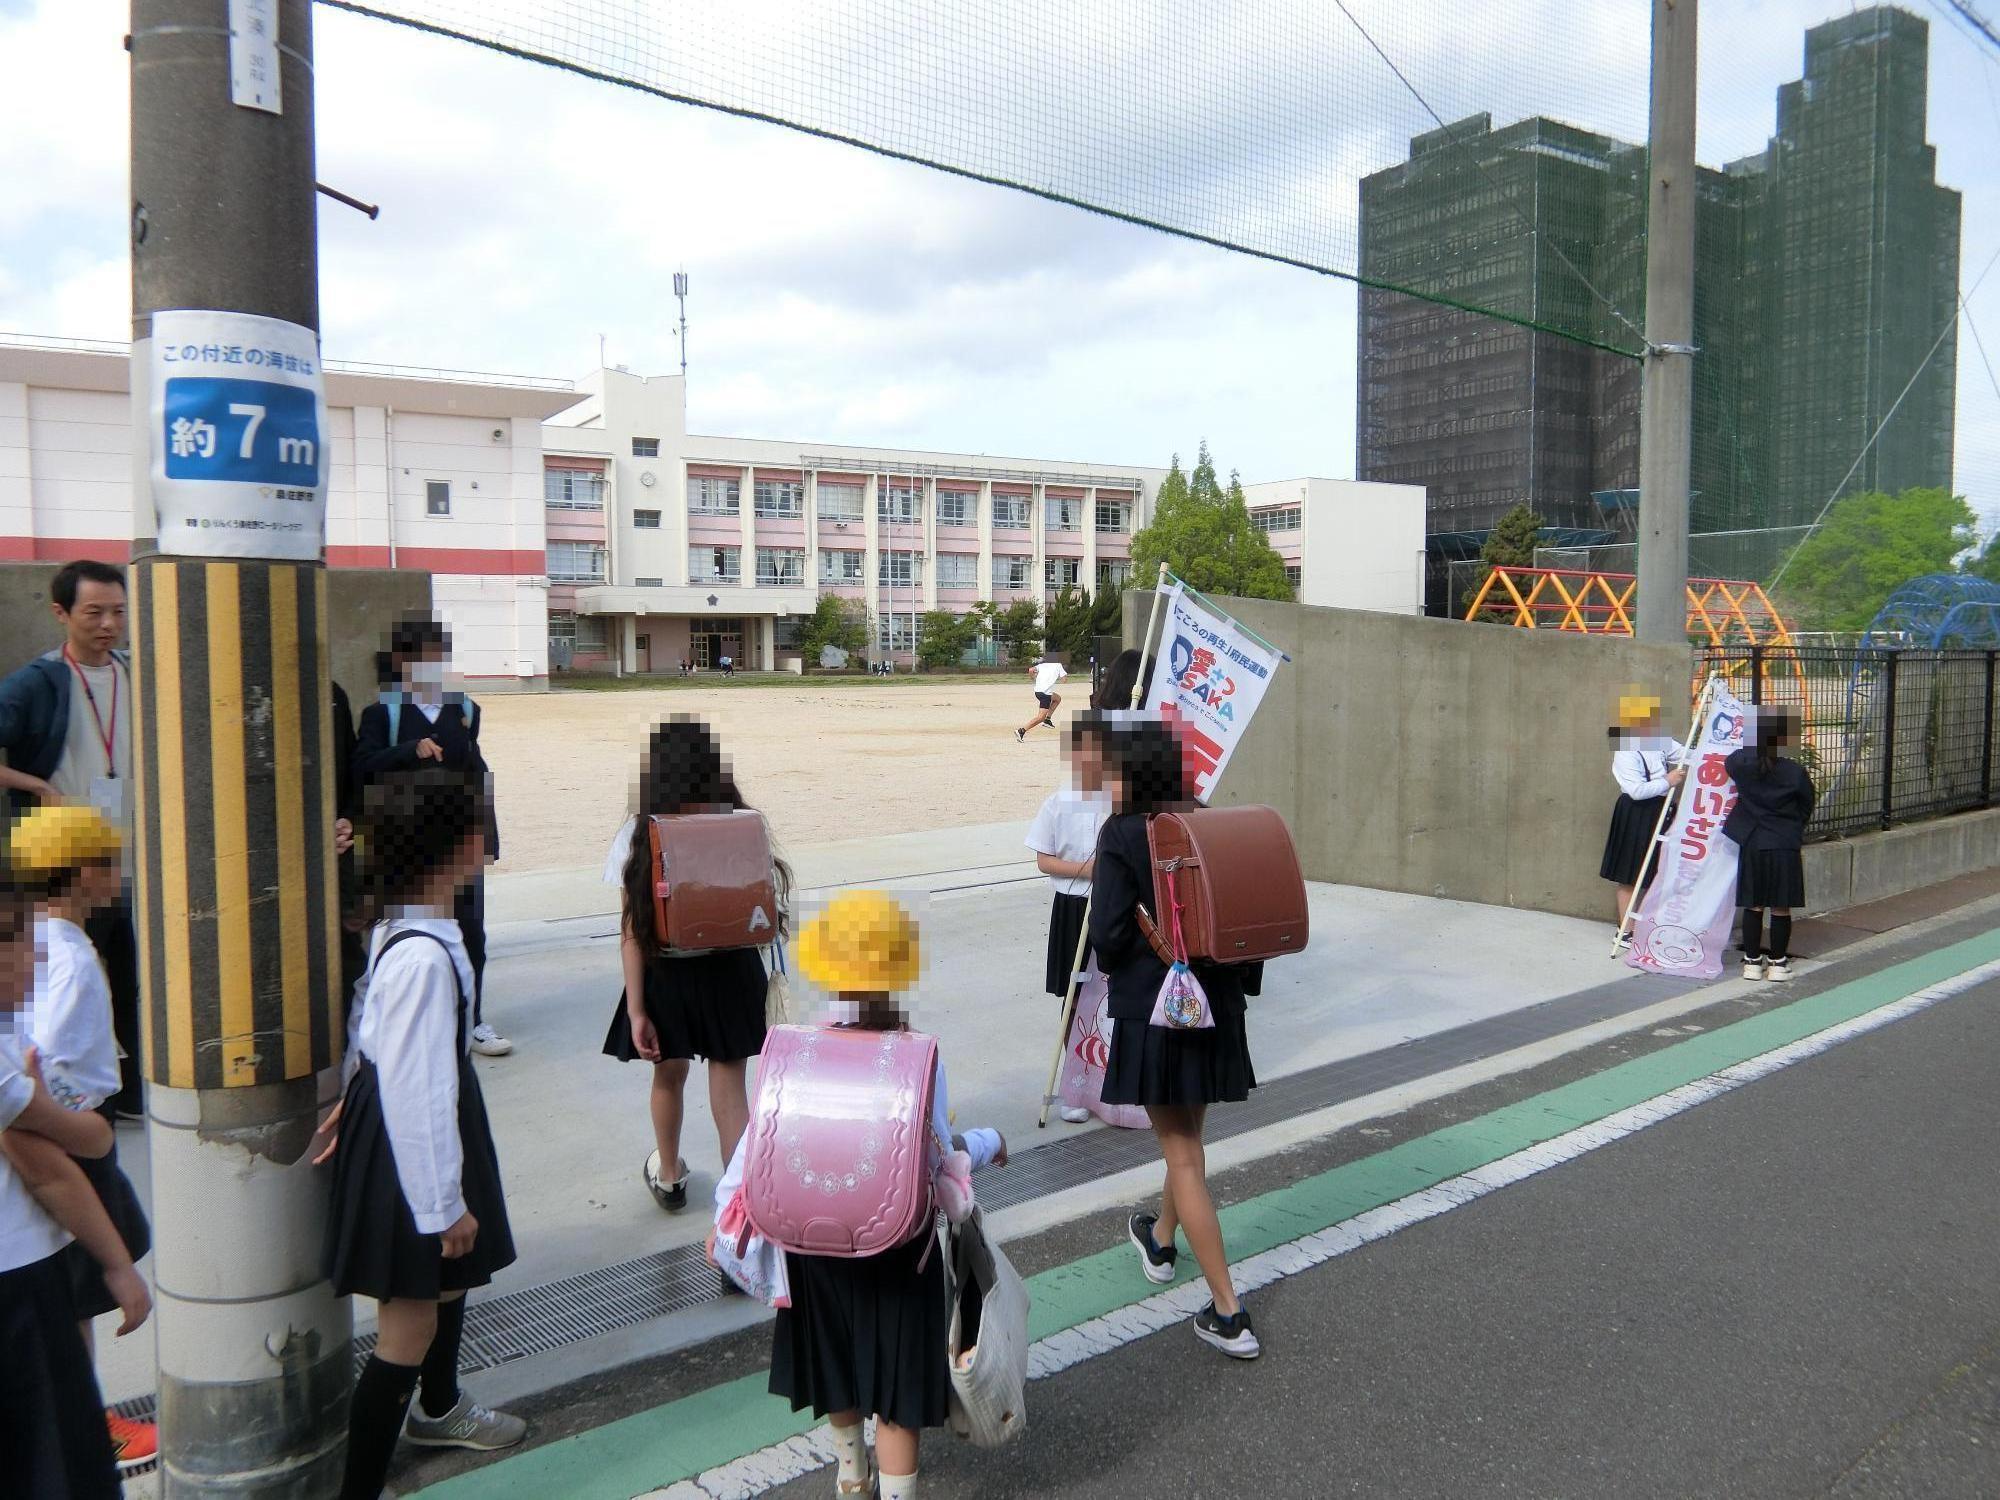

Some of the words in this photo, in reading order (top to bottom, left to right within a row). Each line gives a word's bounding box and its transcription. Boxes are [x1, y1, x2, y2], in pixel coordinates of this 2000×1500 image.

[163, 344, 314, 375] この付近の海抜は
[749, 905, 771, 932] A
